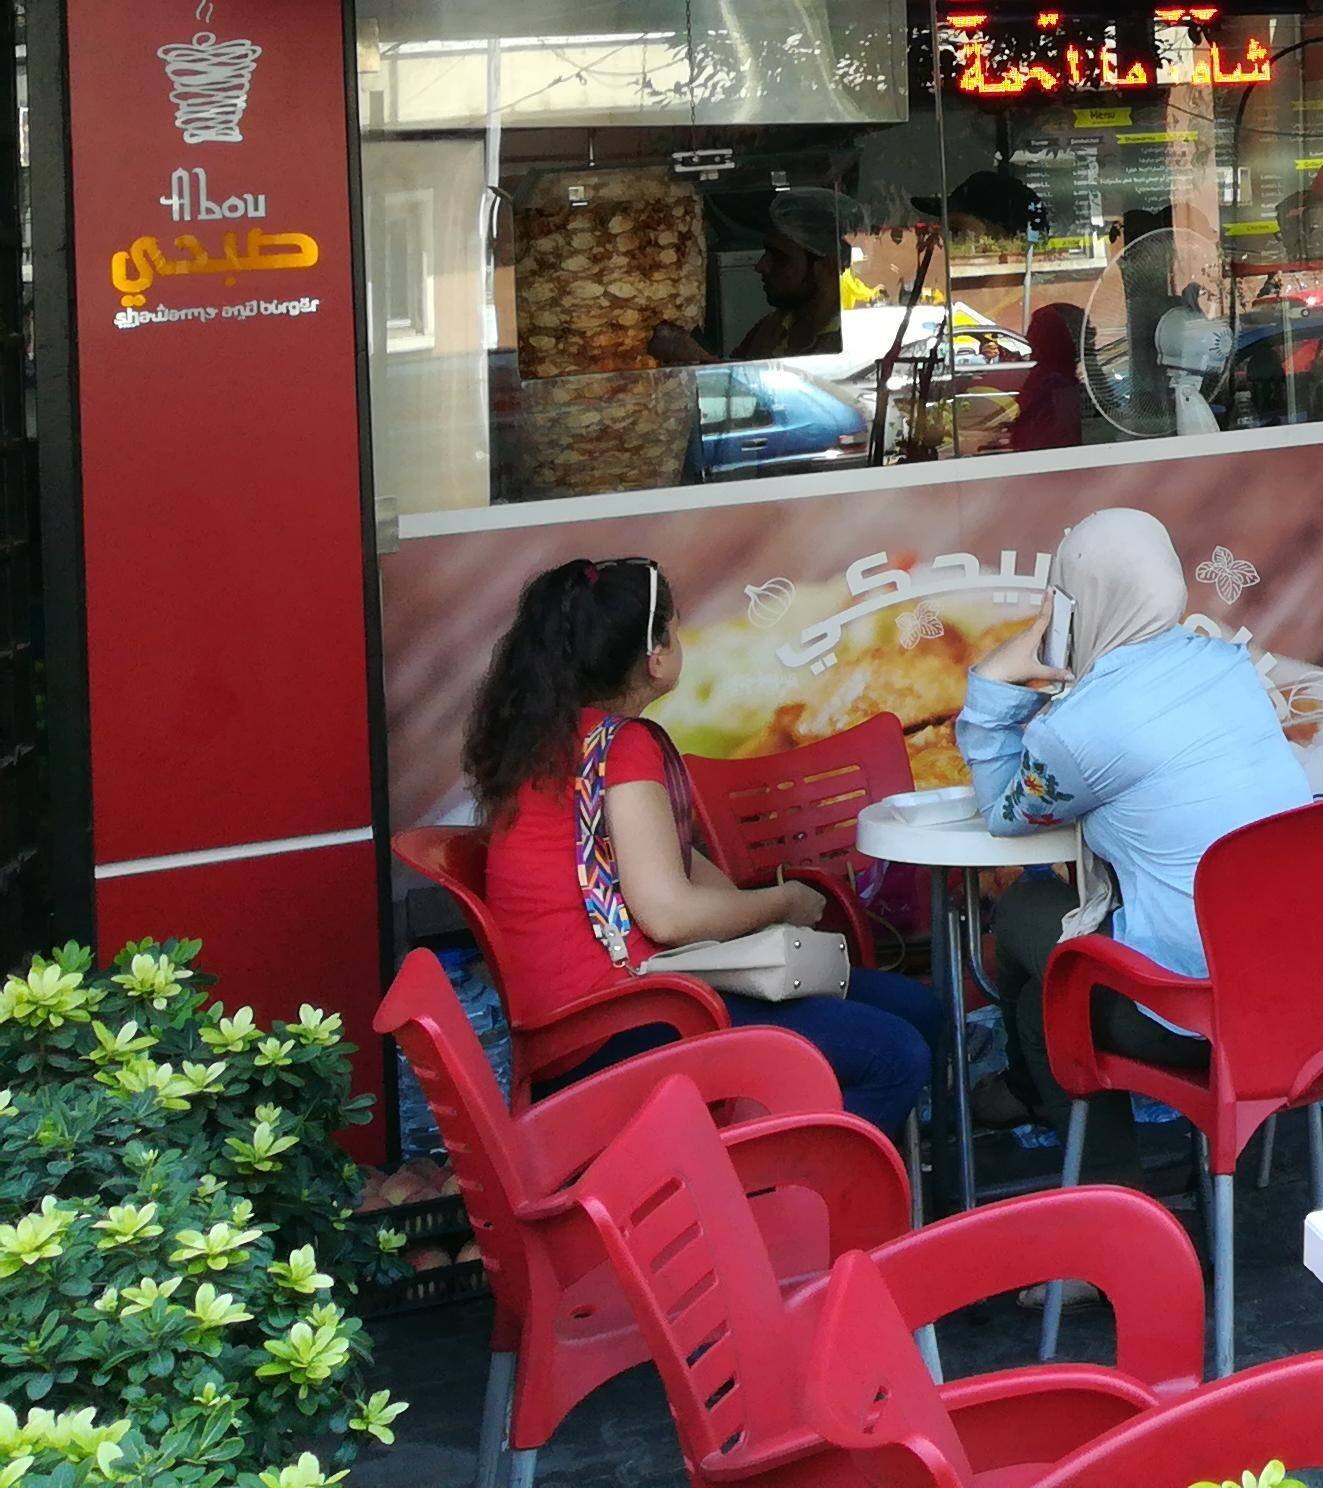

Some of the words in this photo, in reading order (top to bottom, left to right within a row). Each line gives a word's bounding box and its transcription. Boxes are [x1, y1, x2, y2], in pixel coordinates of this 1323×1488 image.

[160, 167, 266, 222] Abou
[111, 227, 319, 308] صبحي
[221, 300, 258, 321] and
[259, 296, 320, 317] burger
